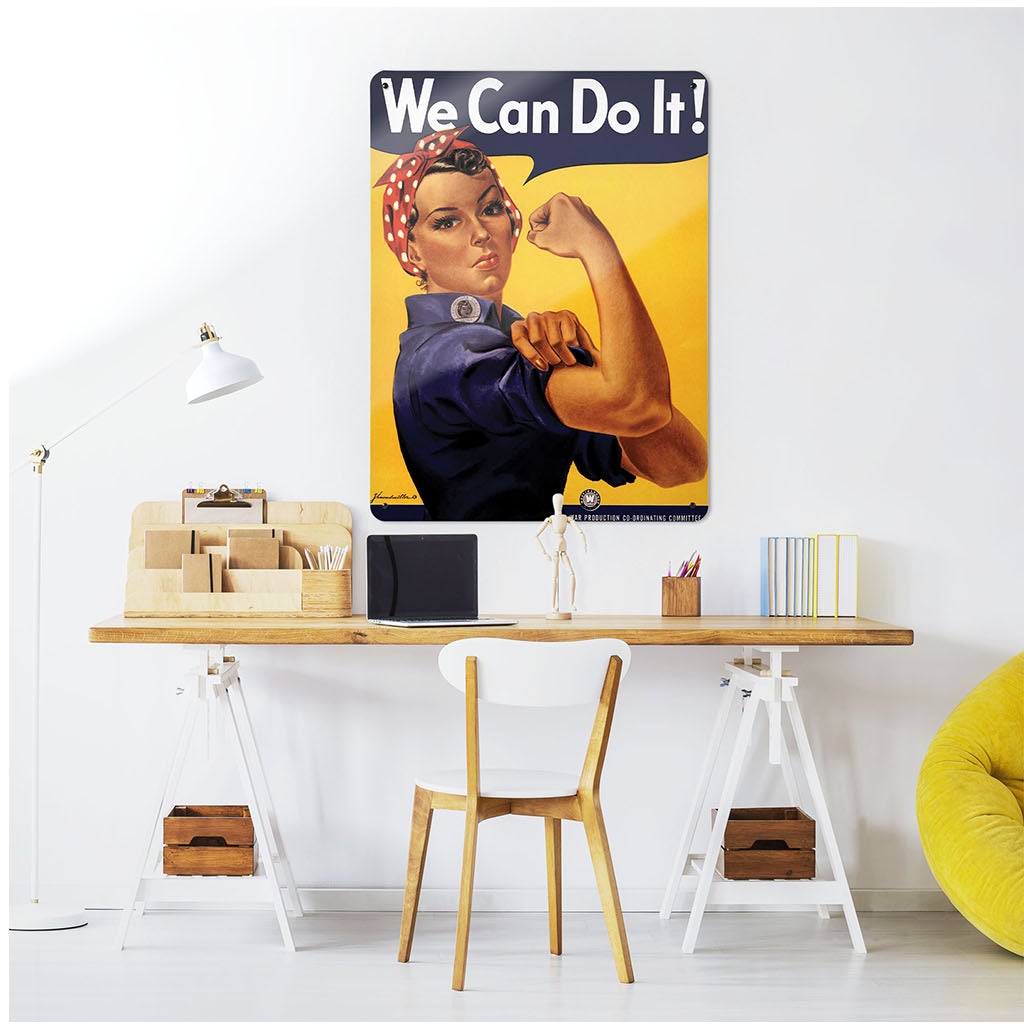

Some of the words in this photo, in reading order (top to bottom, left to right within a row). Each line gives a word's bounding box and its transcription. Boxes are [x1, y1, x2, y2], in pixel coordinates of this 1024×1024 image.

[380, 77, 458, 134] We
[468, 77, 559, 135] Can
[572, 78, 640, 135] Do
[653, 78, 706, 135] It!
[584, 514, 620, 522] PRODUCTION
